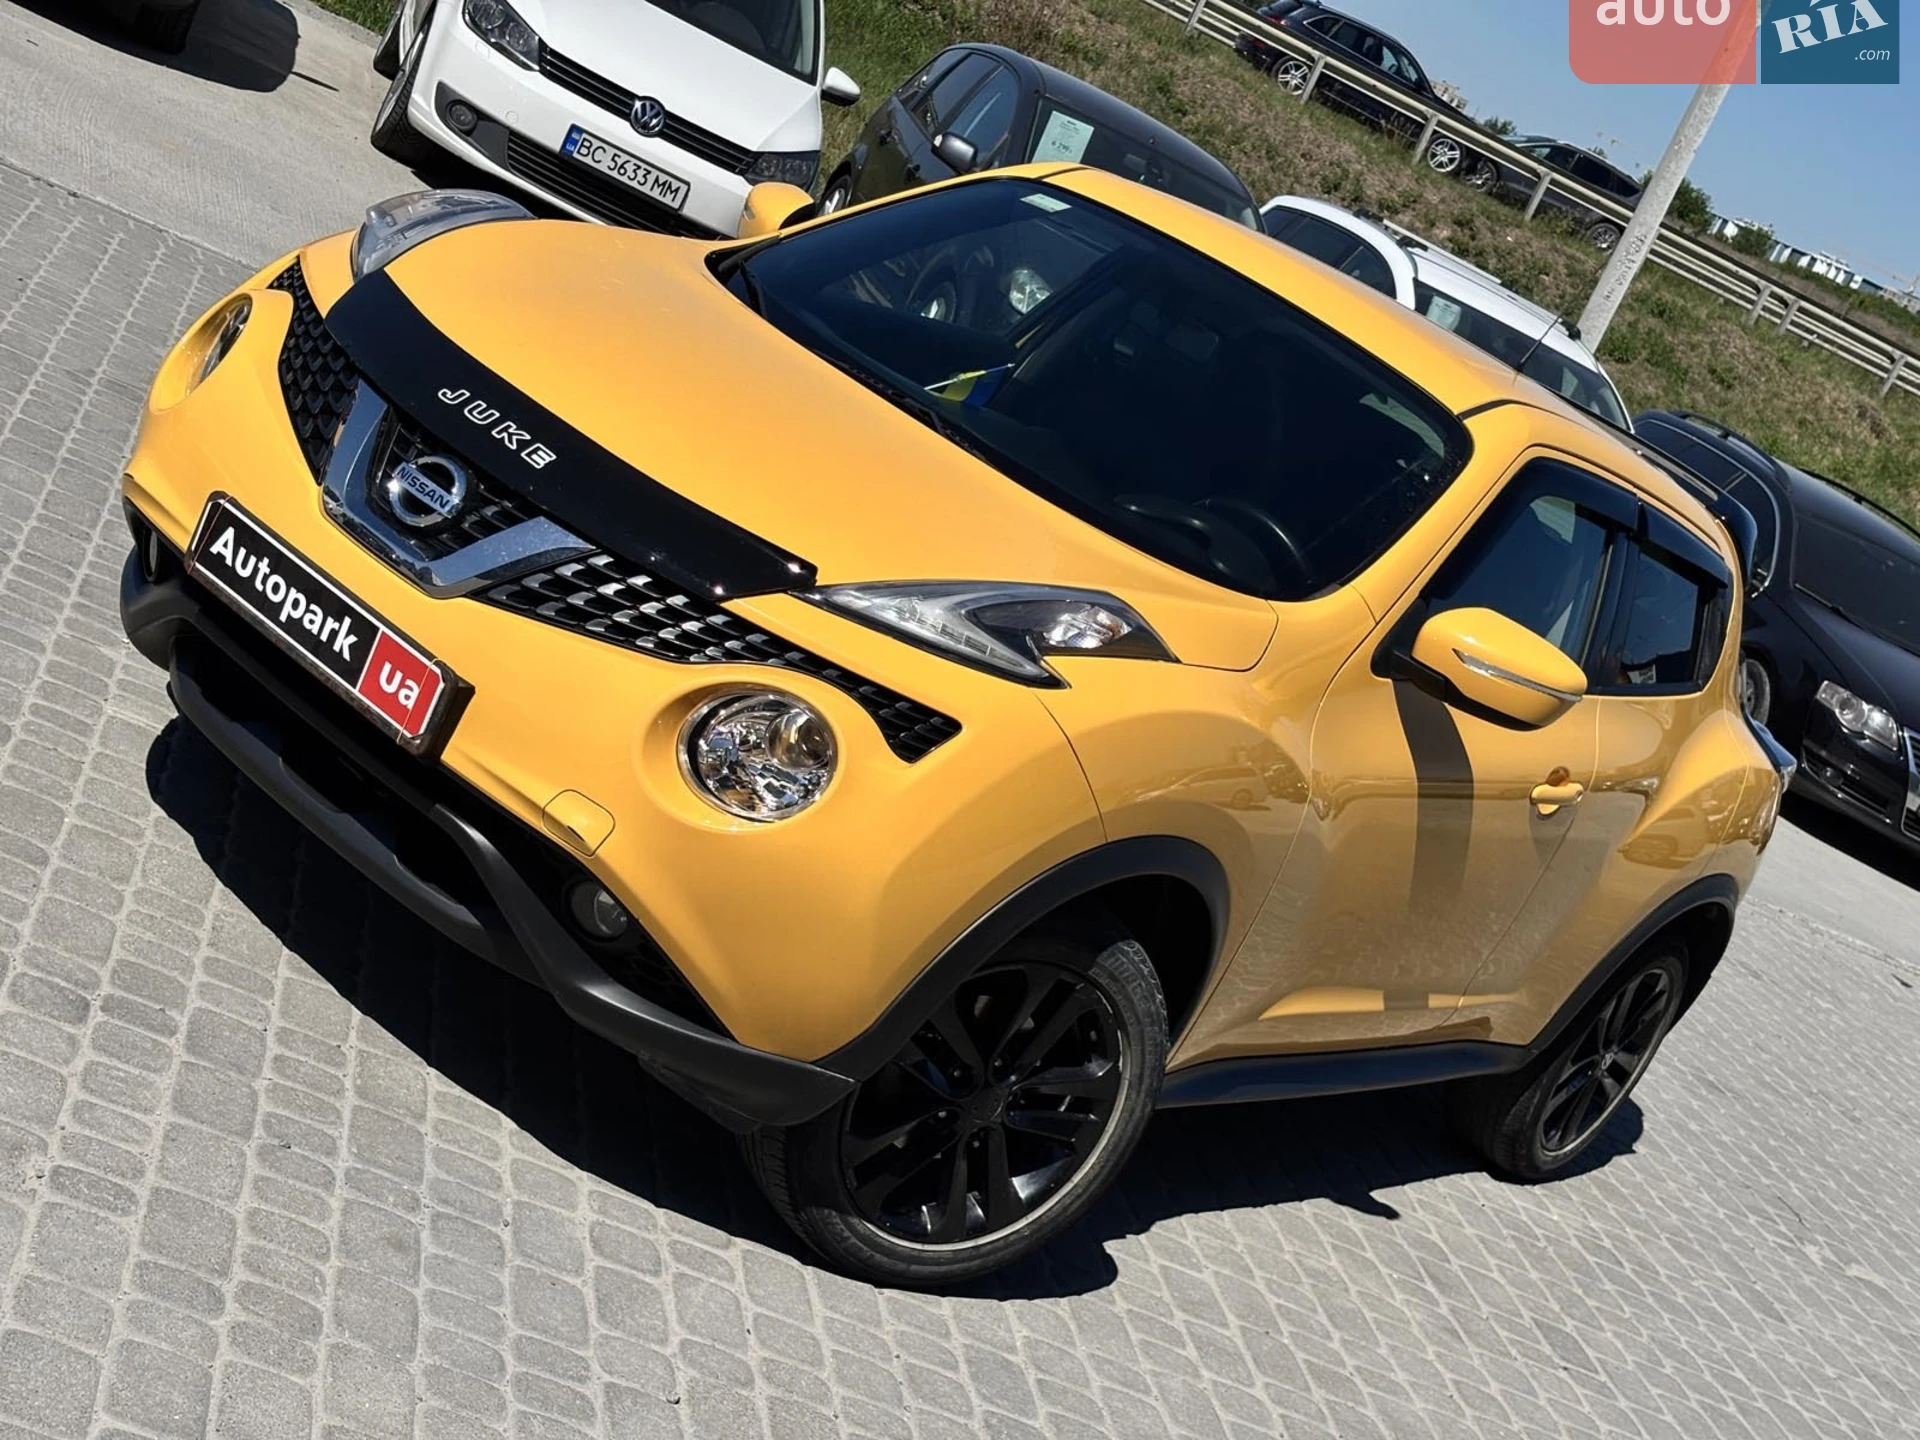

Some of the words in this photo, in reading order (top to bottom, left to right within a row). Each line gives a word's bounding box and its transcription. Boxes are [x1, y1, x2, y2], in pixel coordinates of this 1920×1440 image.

[576, 137, 606, 164] BC
[607, 153, 651, 186] 5633
[650, 175, 681, 202] MM
[437, 388, 557, 469] JUKE
[396, 466, 450, 510] NISSAN
[209, 526, 359, 662] Autopark
[378, 660, 421, 710] ua
